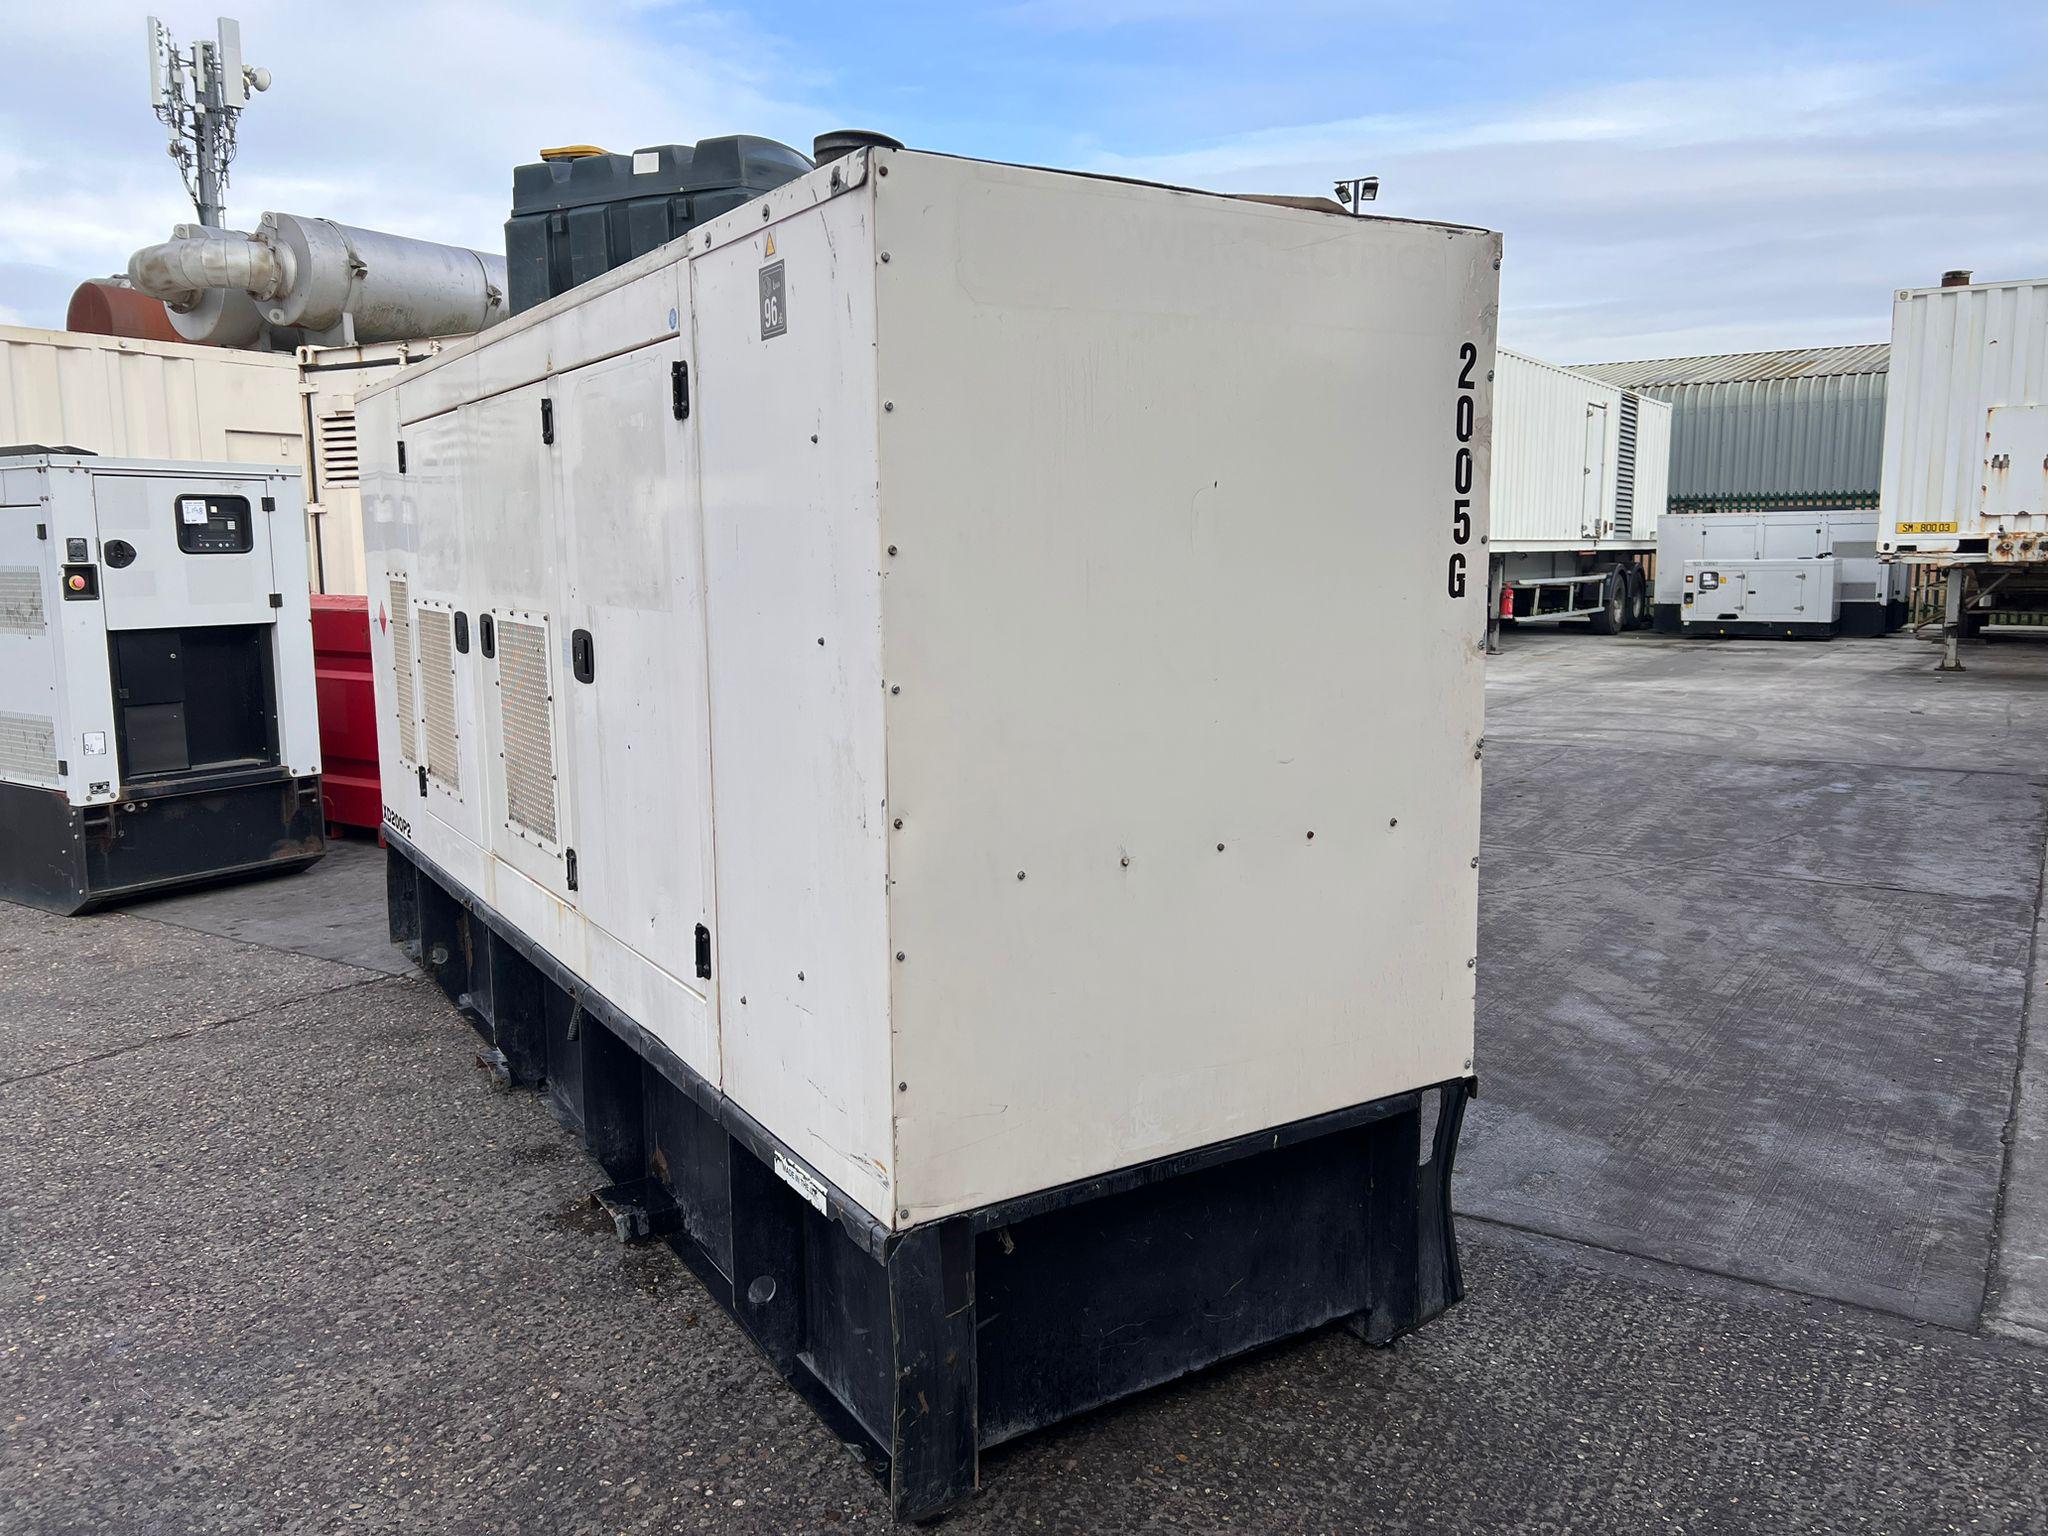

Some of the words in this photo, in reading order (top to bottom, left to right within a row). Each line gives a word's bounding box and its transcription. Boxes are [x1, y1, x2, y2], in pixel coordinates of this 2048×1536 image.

[764, 296, 777, 328] 96
[1448, 342, 1477, 599] 2005G
[1902, 523, 1913, 533] SM
